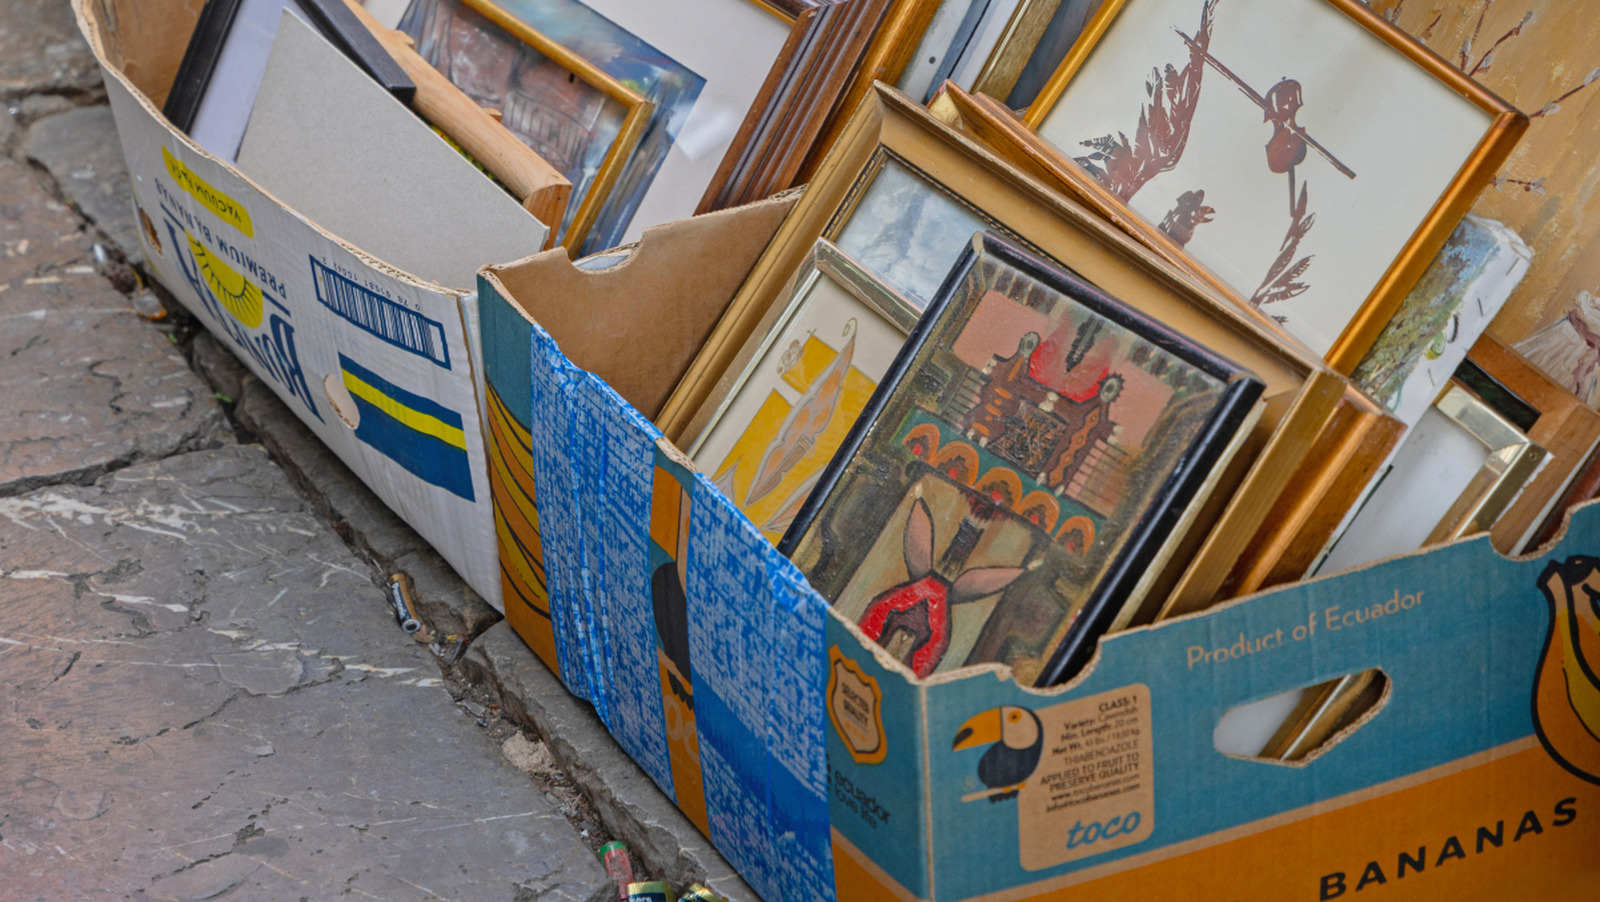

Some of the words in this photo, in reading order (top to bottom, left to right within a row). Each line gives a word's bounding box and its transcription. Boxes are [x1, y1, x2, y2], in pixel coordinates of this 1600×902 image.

[171, 161, 194, 189] PACK
[154, 177, 213, 243] BANANAS
[194, 180, 243, 224] VACUUM
[216, 234, 288, 300] PREMIUM
[1186, 632, 1284, 670] Product
[1292, 612, 1317, 641] of
[1325, 589, 1426, 631] Ecuador
[1040, 768, 1080, 785] APPLIED
[1082, 763, 1096, 774] TO
[1097, 755, 1124, 770] FRUIT
[1126, 751, 1140, 762] TO
[1064, 740, 1139, 765] THIABENDAZOLE
[1049, 773, 1097, 792] PRESERVE
[1098, 762, 1139, 779] QUALITY
[1066, 810, 1142, 850] toco
[1319, 797, 1577, 901] BANANAS
